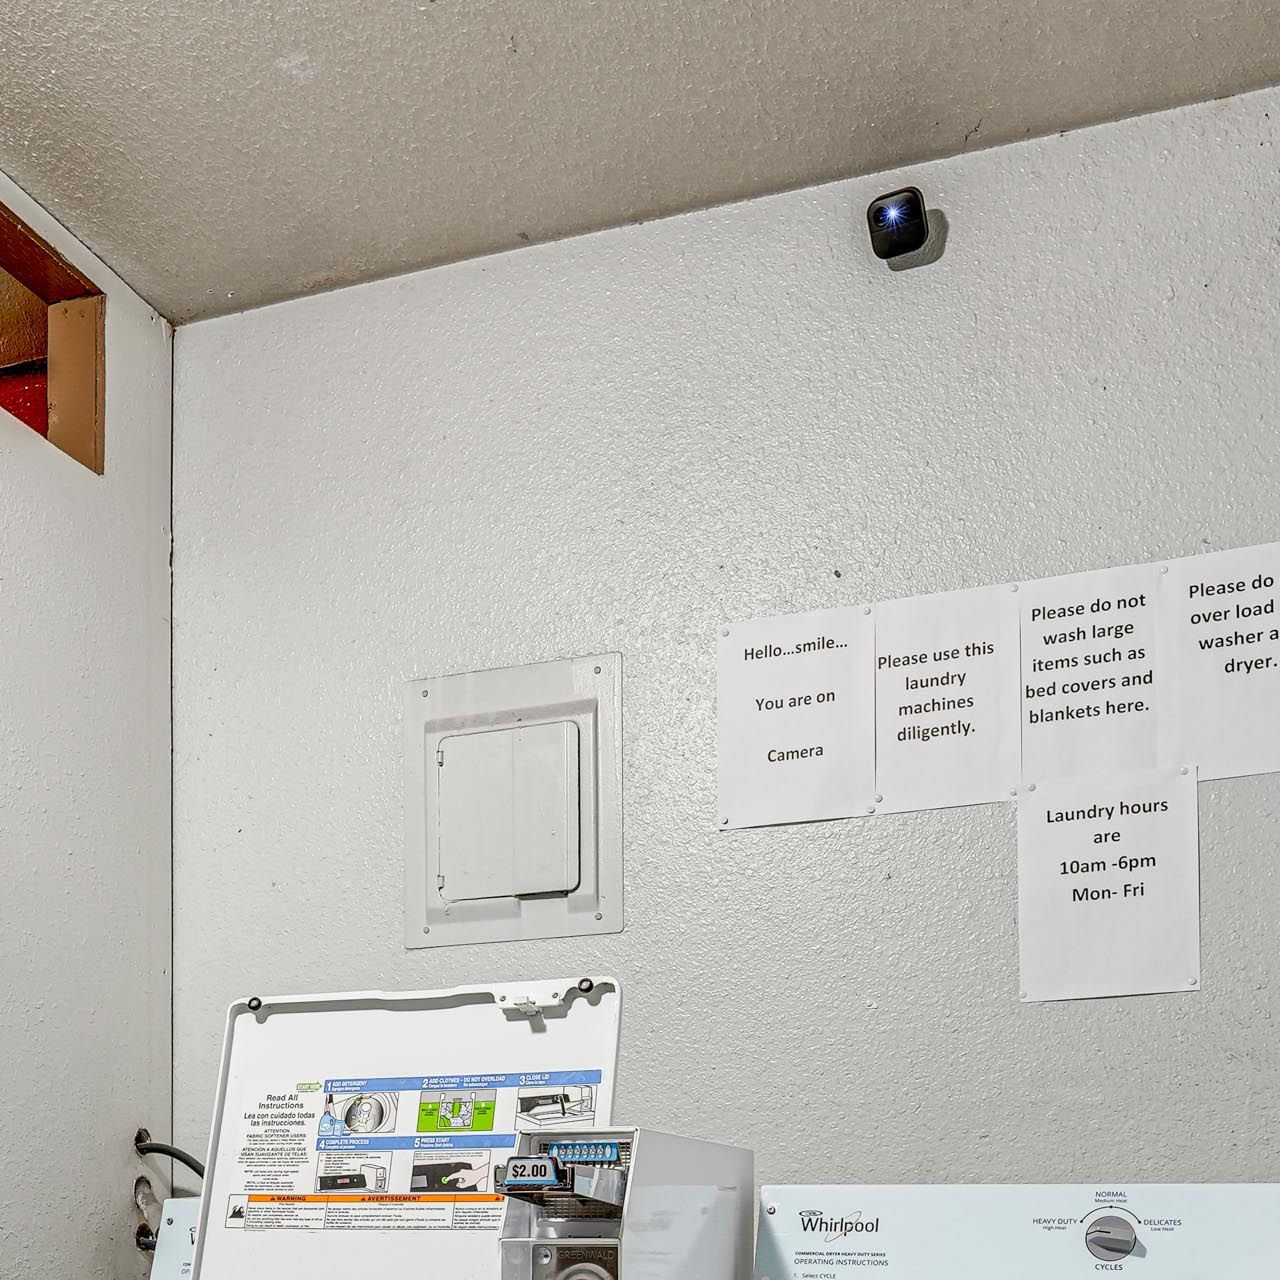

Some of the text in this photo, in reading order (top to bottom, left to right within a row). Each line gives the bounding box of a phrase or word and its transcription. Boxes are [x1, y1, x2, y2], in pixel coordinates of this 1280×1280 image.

[1190, 582, 1245, 598] Please
[1252, 575, 1274, 589] do
[1032, 595, 1146, 621] Please do not
[1191, 610, 1230, 624] over
[1236, 599, 1274, 618] load
[1043, 624, 1133, 645] wash large
[1199, 631, 1263, 649] washer
[745, 636, 847, 660] Hello...smile...
[879, 642, 994, 669] Please use this
[1033, 648, 1145, 672] items such as
[1225, 657, 1277, 674] dryer.
[906, 672, 966, 690] laundry
[1026, 670, 1152, 698] bed covers and
[756, 692, 835, 711] You are on
[899, 697, 973, 716] machines
[1030, 701, 1149, 723] blankets here.
[898, 720, 975, 741] diligently.
[768, 747, 823, 762] Camera
[1047, 801, 1168, 823] Laundry hours
[1094, 832, 1120, 843] are
[1060, 856, 1156, 874] 10am -6pm
[1073, 882, 1144, 902] Mon- Fri
[328, 1082, 332, 1091] 1
[422, 1079, 428, 1088] 2
[519, 1076, 525, 1085] 3
[320, 1140, 325, 1148] 4
[414, 1138, 420, 1147] 5
[512, 1164, 547, 1178] $2.00
[801, 1217, 879, 1236] Whirlpool
[559, 1250, 615, 1260] GREENWALD
